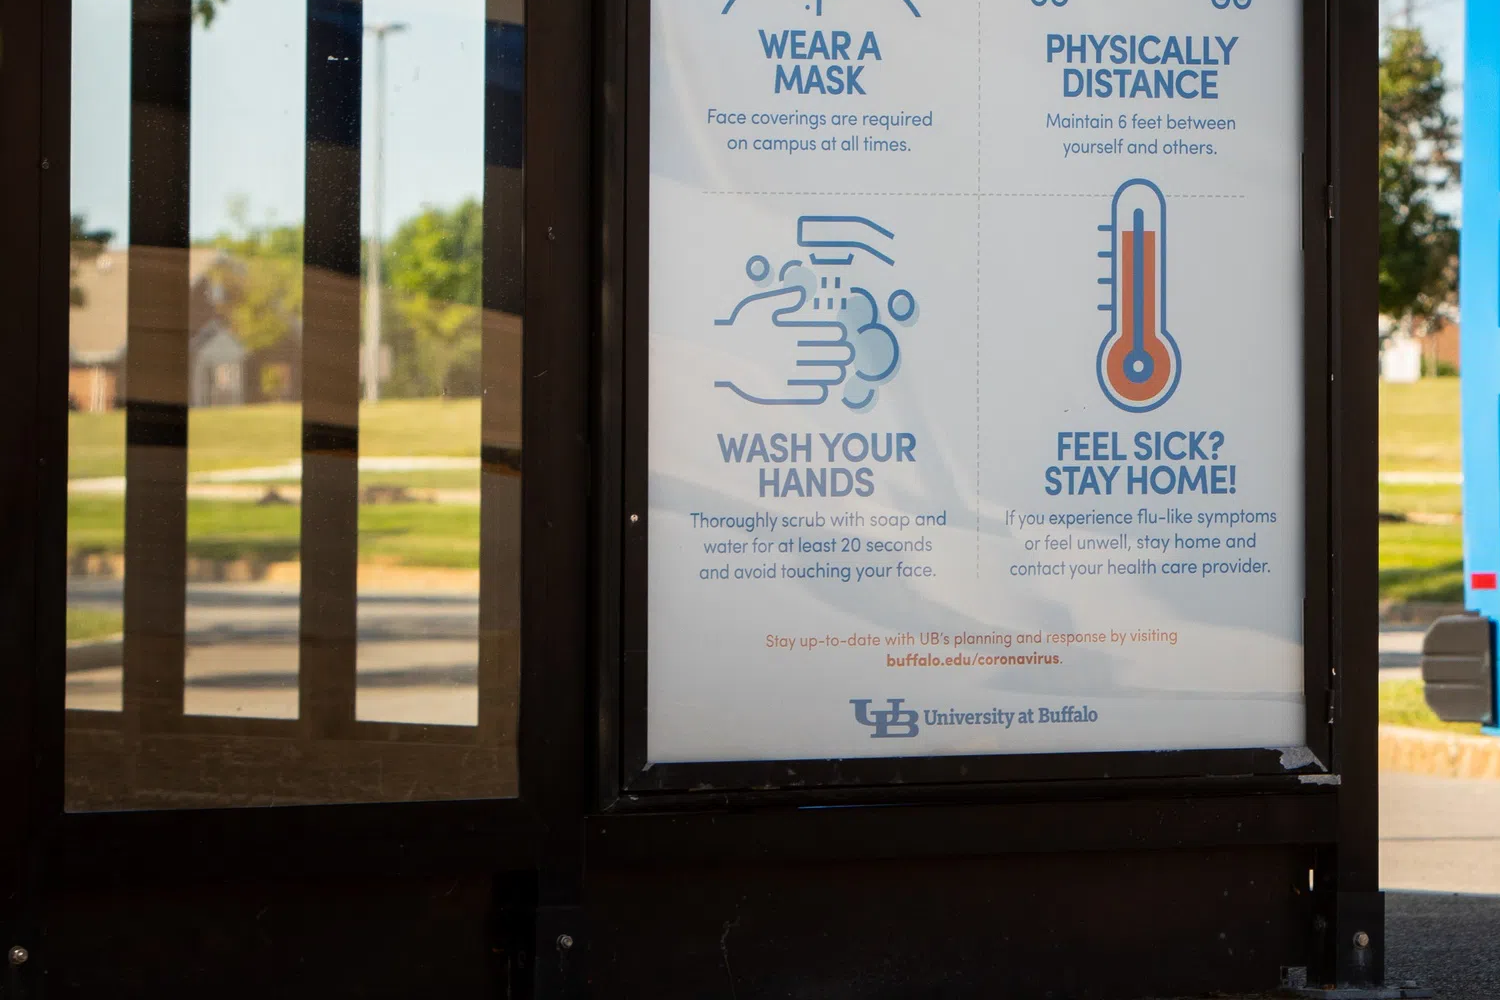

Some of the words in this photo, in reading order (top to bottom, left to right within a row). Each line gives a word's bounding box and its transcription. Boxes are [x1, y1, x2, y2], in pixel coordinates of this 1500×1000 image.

[758, 29, 851, 60] WEAR
[857, 31, 882, 60] A
[1047, 33, 1239, 65] PHYSICALLY
[774, 64, 867, 95] MASK
[1063, 67, 1218, 99] DISTANCE
[708, 109, 746, 124] Face
[751, 110, 826, 130] coverings
[831, 114, 857, 125] are
[863, 111, 932, 130] required
[1046, 113, 1113, 128] Maintain
[1119, 114, 1127, 129] 6
[1132, 114, 1162, 129] feet
[1167, 114, 1235, 130] between
[727, 137, 747, 150] on
[753, 137, 816, 155] campus
[821, 137, 837, 150] at
[841, 135, 858, 151] all
[863, 136, 911, 151] times.
[1063, 138, 1123, 158] yourself
[1127, 139, 1157, 154] and
[1163, 139, 1217, 155] others.
[717, 433, 812, 463] WASH
[819, 432, 916, 462] YOUR
[1057, 432, 1127, 461] FEEL
[1134, 430, 1224, 461] SICK?
[759, 467, 874, 497] HANDS
[1045, 466, 1120, 496] STAY
[1127, 466, 1236, 495] HOME!
[690, 512, 778, 532] Thoroughly
[782, 511, 825, 527] scrub
[829, 511, 864, 527] with
[871, 512, 910, 531] soap
[915, 510, 947, 526] and
[1006, 508, 1015, 525] If
[1019, 513, 1044, 529] you
[1048, 509, 1133, 529] experience
[1137, 508, 1193, 524] flu-like
[1197, 509, 1276, 528] symptoms
[704, 540, 748, 553] water
[752, 537, 774, 553] for
[777, 538, 794, 552] at
[799, 537, 837, 553] least
[841, 537, 861, 552] 20
[866, 536, 932, 552] seconds
[1025, 540, 1040, 550] or
[1045, 534, 1071, 550] feel
[1078, 533, 1132, 551] unwell,
[1137, 535, 1170, 553] stay
[1175, 533, 1220, 548] home
[1225, 532, 1256, 548] and
[699, 564, 729, 580] and
[734, 563, 776, 579] avoid
[781, 562, 851, 582] touching
[856, 567, 893, 582] your
[896, 561, 936, 577] face.
[1010, 561, 1066, 576] contact
[1069, 564, 1103, 579] your
[1108, 559, 1156, 575] health
[1160, 562, 1197, 574] care
[1202, 557, 1272, 578] provider.
[766, 634, 795, 650] Stay
[800, 633, 880, 650] up-to-date
[885, 632, 914, 646] with
[954, 631, 1012, 648] planning
[1016, 630, 1042, 644] and
[1047, 633, 1106, 646] response
[1111, 629, 1126, 646] by
[1130, 630, 1177, 645] visiting
[887, 650, 1062, 668] buffalo.edu/coronavirus.
[849, 699, 920, 739] UB
[924, 708, 1015, 729] University
[1018, 709, 1034, 723] at
[1038, 704, 1098, 723] Buffalo
